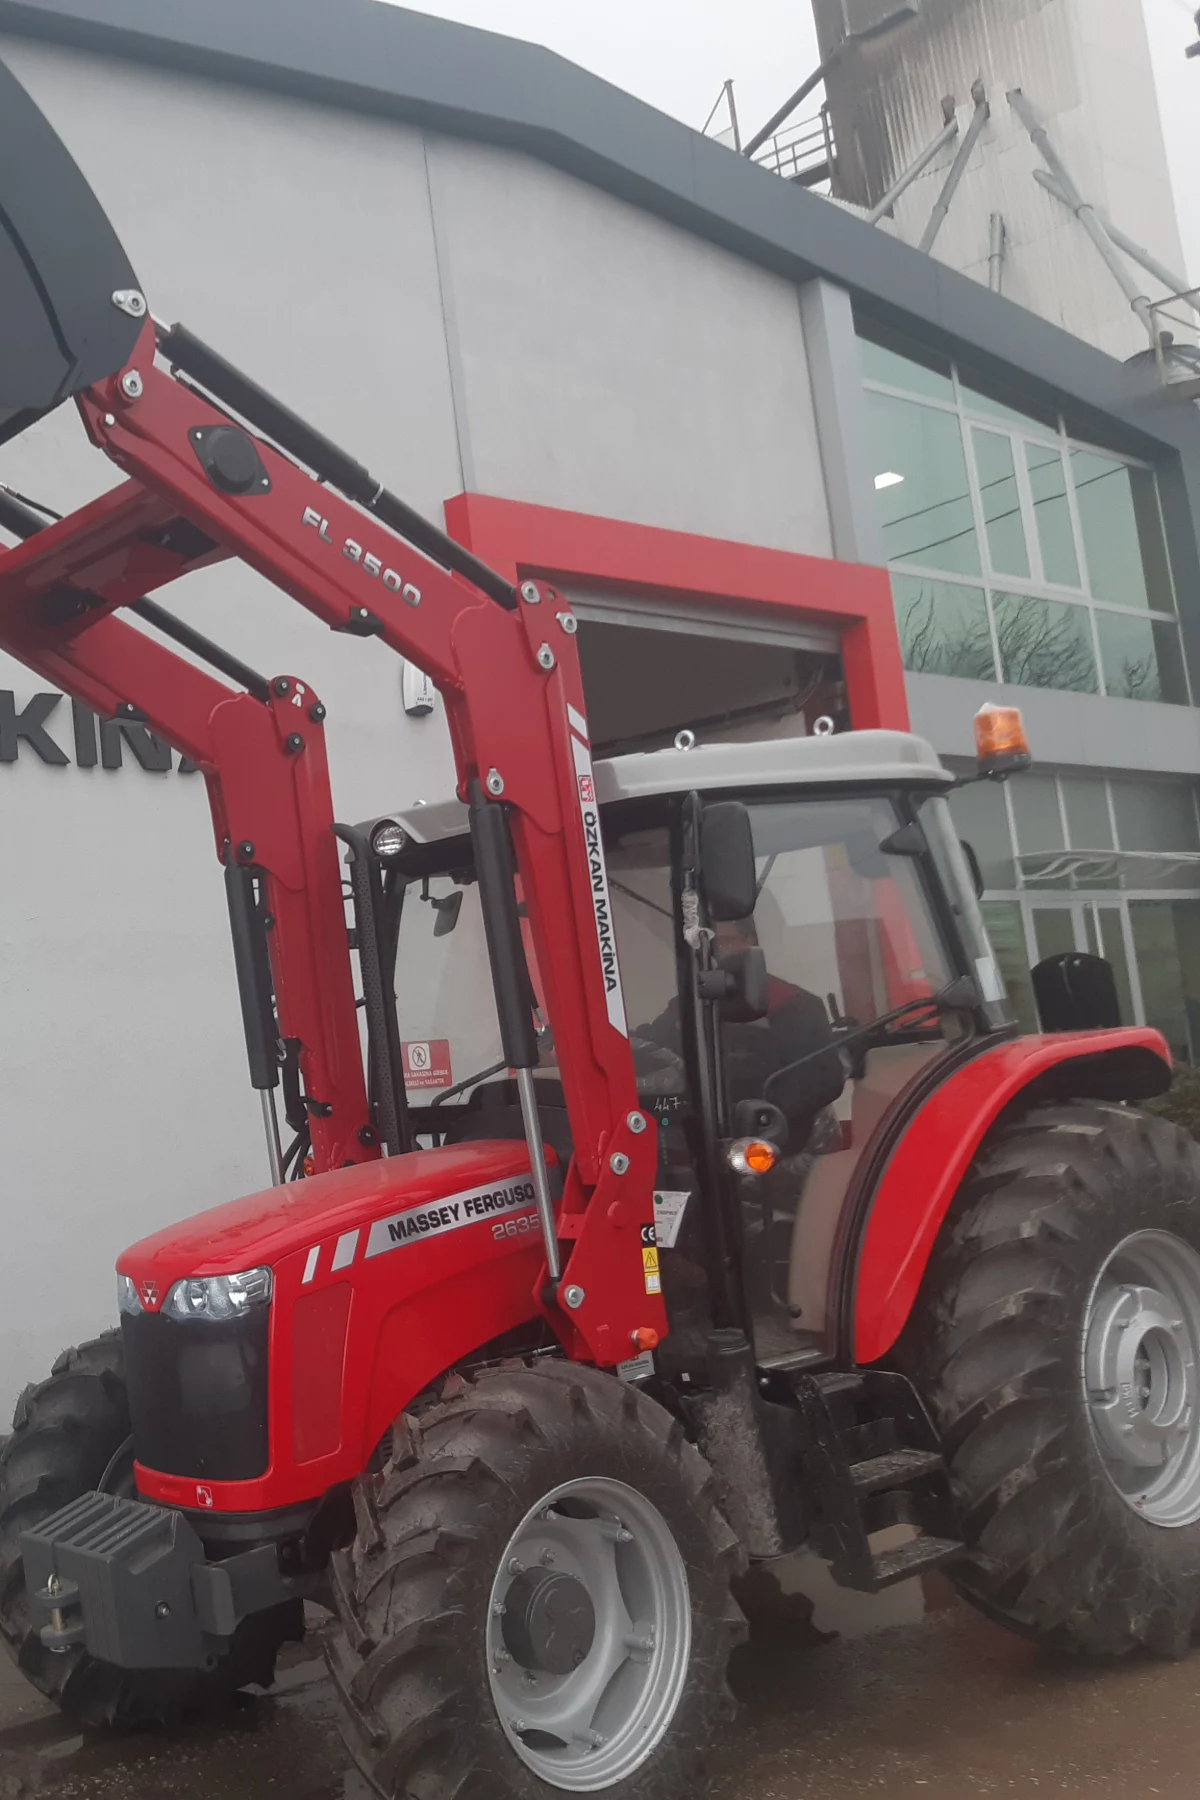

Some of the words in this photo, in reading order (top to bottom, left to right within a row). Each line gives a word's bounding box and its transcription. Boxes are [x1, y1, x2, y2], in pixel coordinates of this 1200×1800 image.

[302, 506, 333, 545] FL
[342, 538, 421, 608] 3500
[583, 811, 604, 892] ÖZKAN
[595, 899, 618, 993] MAKİNA
[387, 1204, 460, 1242] MASSEY
[463, 1182, 535, 1218] FERGUSO
[491, 1213, 541, 1241] 2635
